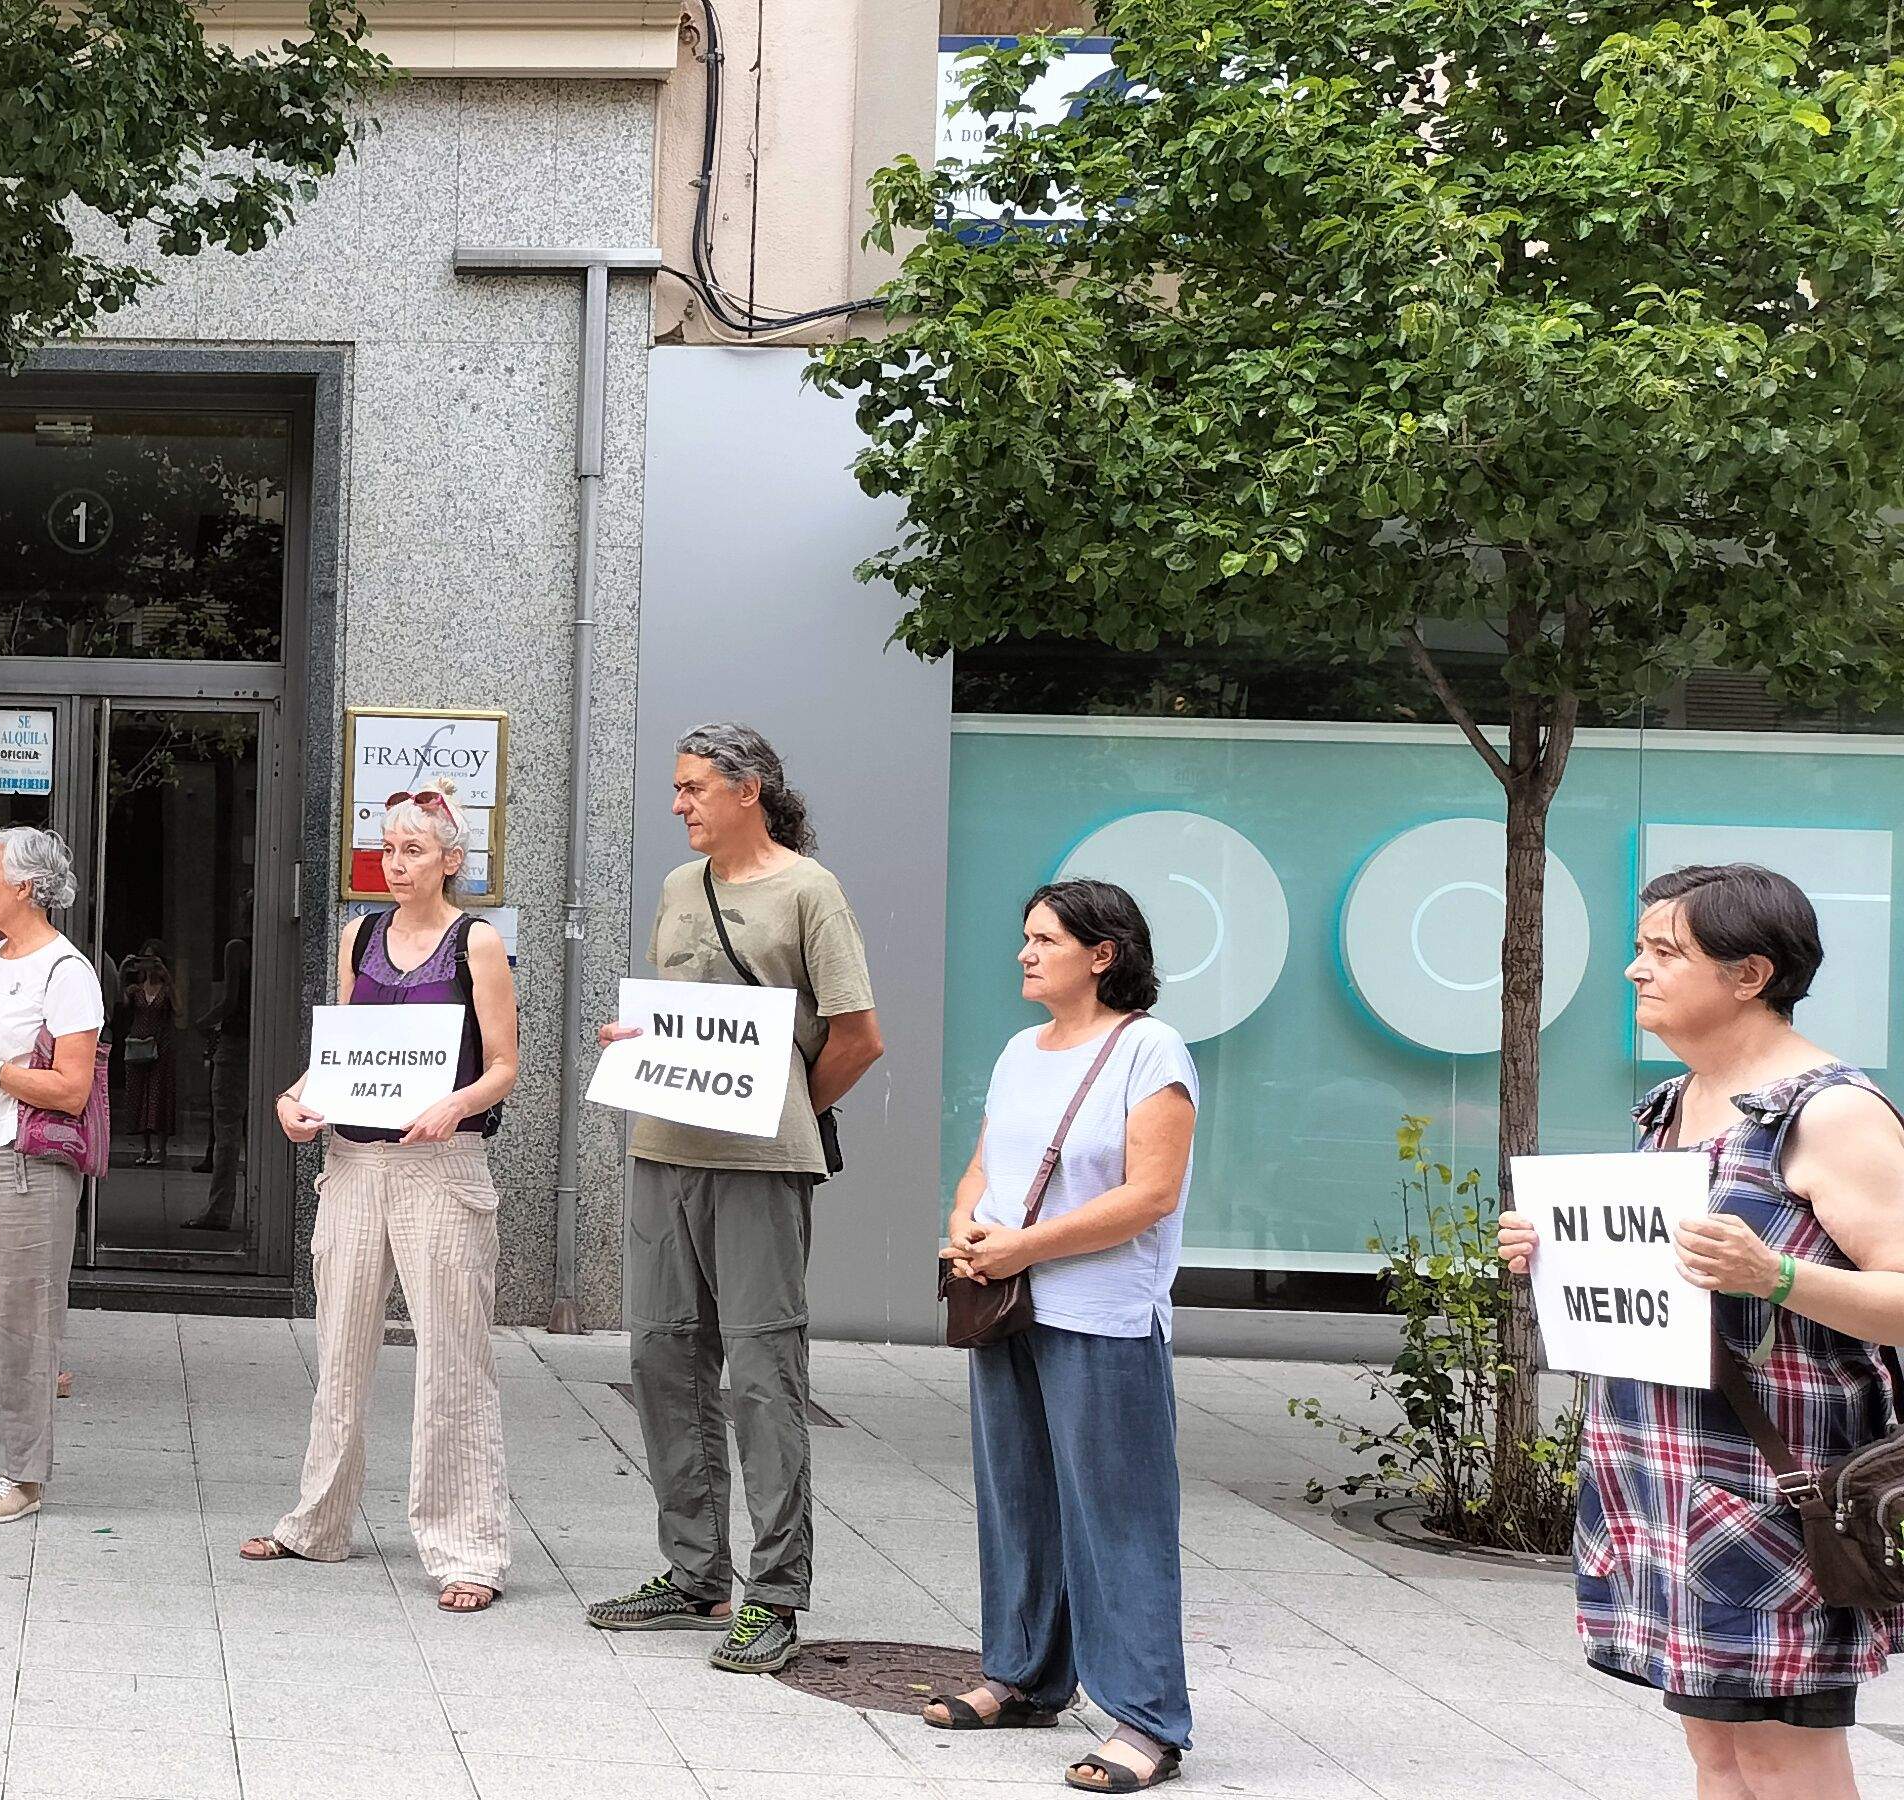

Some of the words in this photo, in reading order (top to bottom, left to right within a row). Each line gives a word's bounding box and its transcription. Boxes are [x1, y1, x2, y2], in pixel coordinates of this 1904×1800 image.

[73, 502, 87, 542] 1
[18, 715, 31, 728] SE
[1, 731, 48, 747] ALQUILA
[0, 749, 39, 760] OFICINA
[653, 1013, 684, 1038] NI
[696, 1016, 760, 1045] UNA
[321, 1050, 342, 1066] EL
[347, 1049, 447, 1066] MACHISMO
[350, 1082, 403, 1098] MATA
[634, 1060, 755, 1099] MENOS
[1553, 1206, 1589, 1241] NI
[1603, 1206, 1670, 1243] UNA
[1563, 1286, 1669, 1328] MENOS
